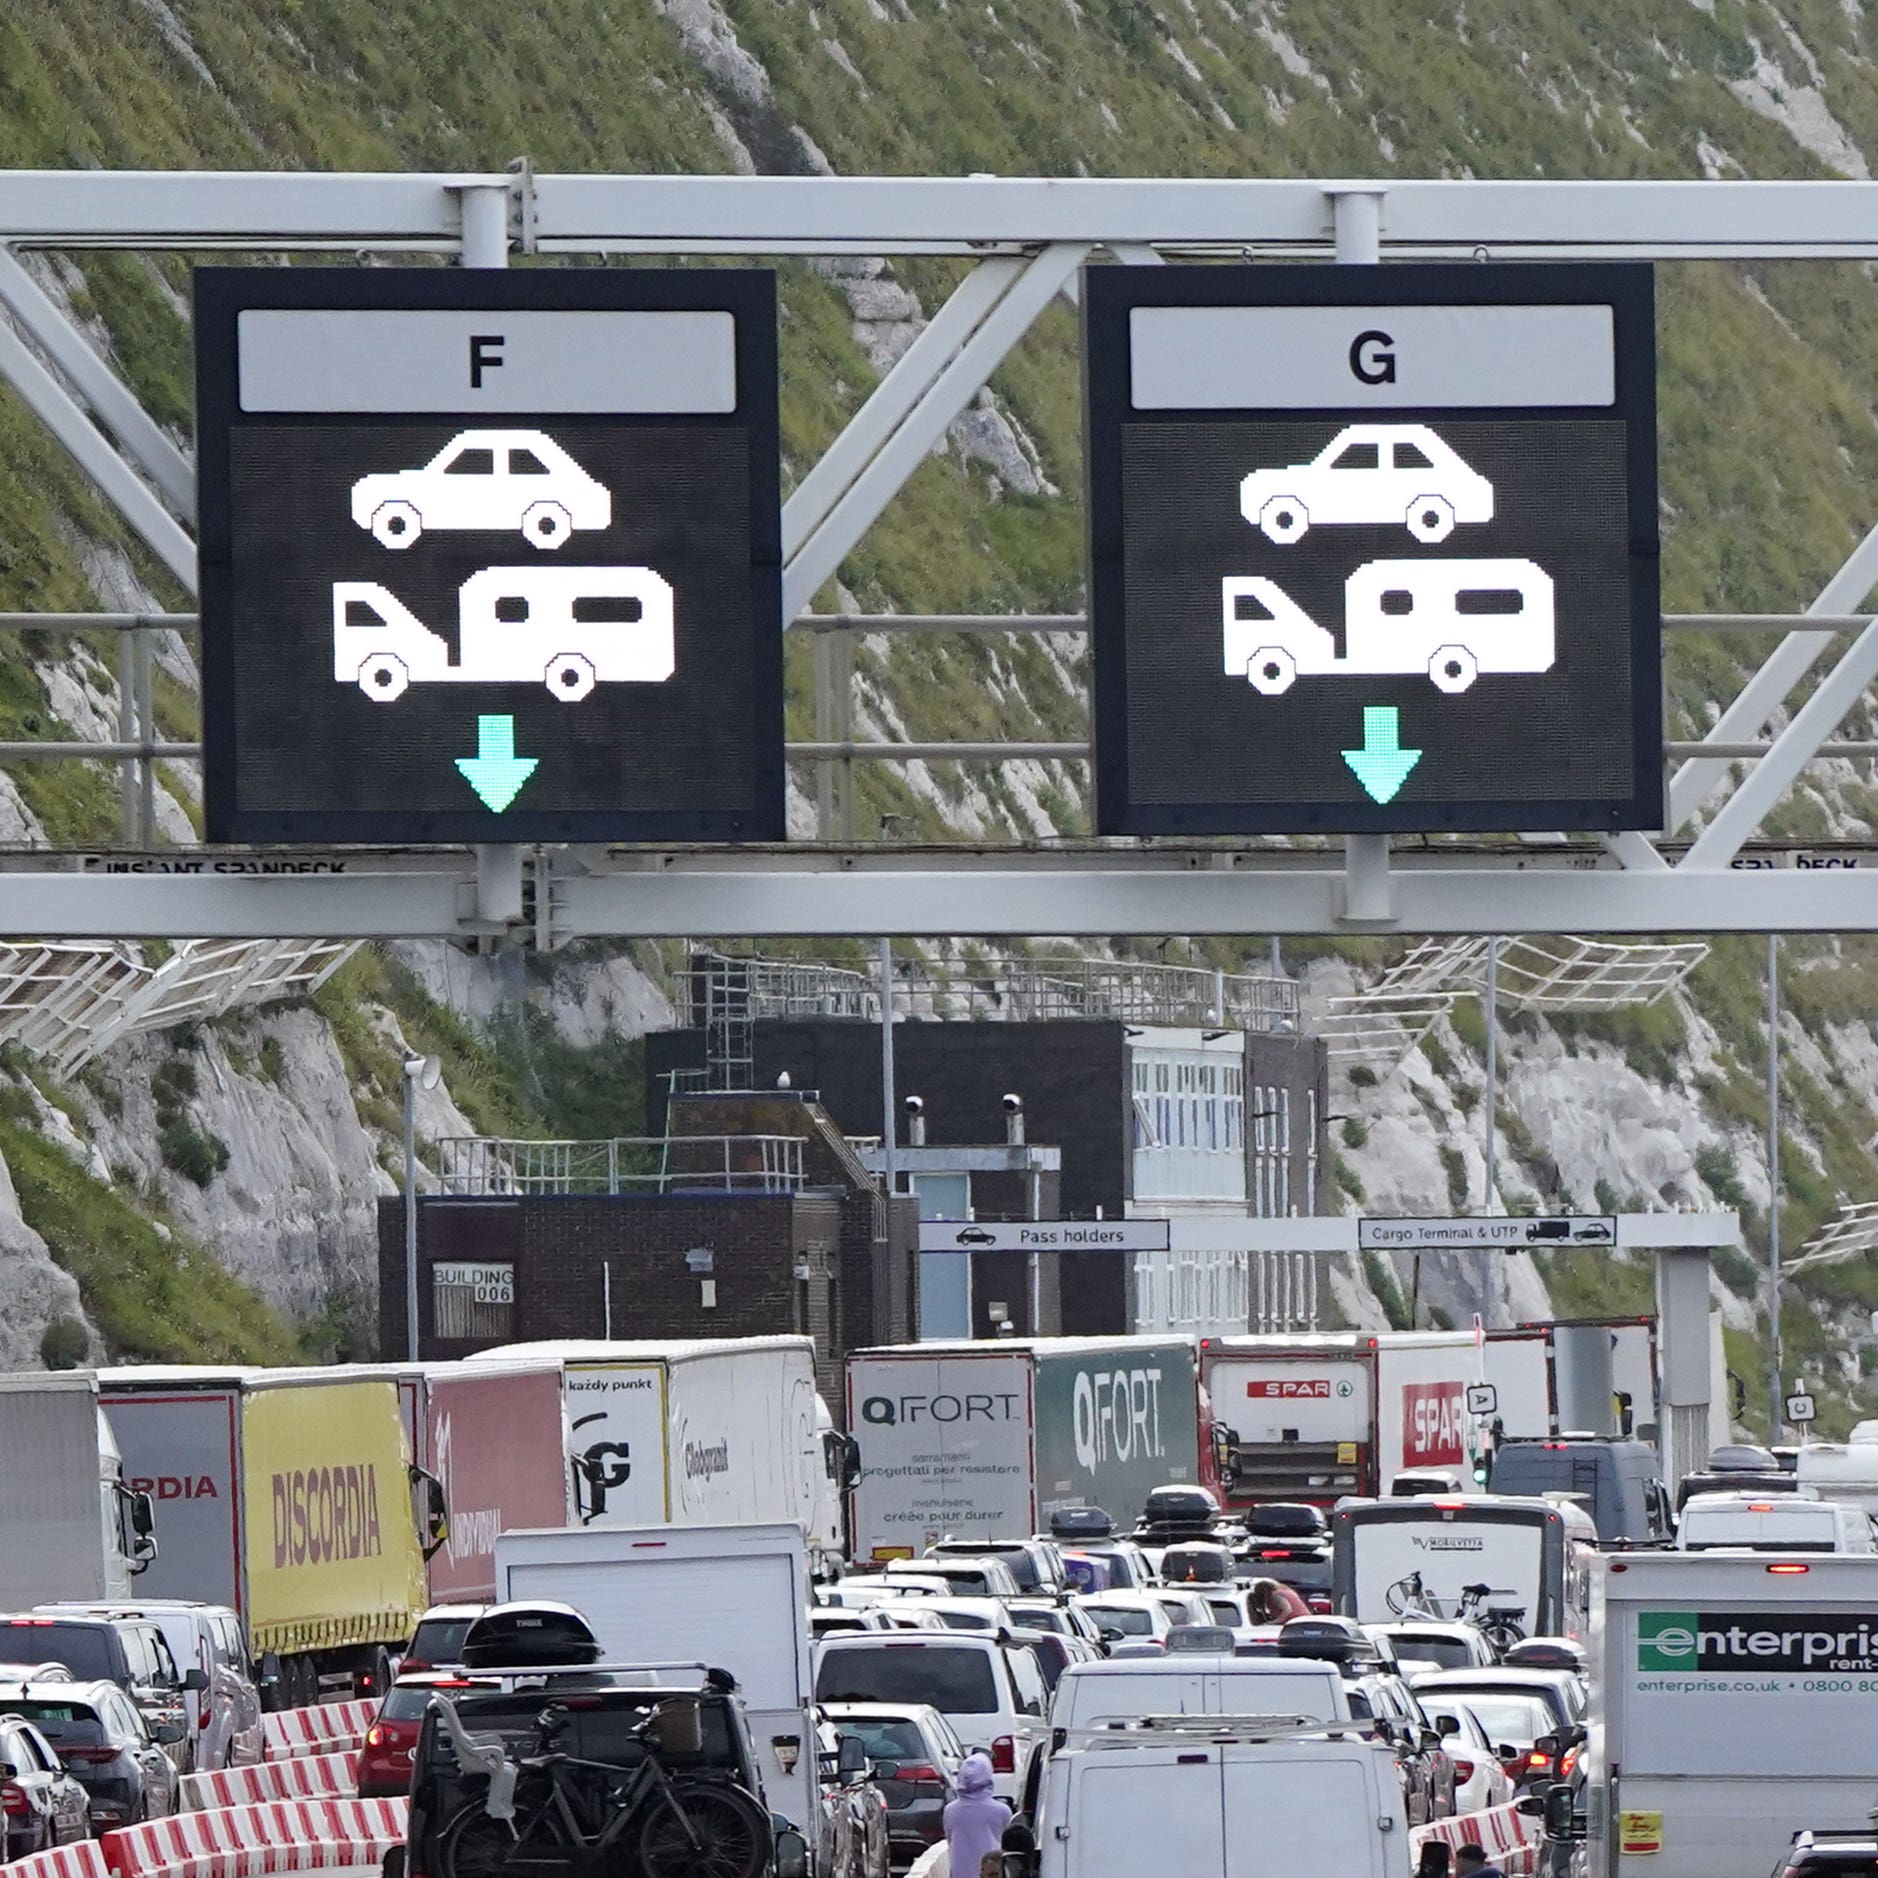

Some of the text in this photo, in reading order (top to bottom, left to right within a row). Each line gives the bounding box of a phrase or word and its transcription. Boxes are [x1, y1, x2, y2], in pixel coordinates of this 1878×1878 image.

[470, 336, 504, 388] F
[1350, 331, 1395, 384] G
[1020, 1229, 1124, 1243] Pass holders
[1372, 1226, 1518, 1242] Cargo Terminal & UTP
[433, 1269, 515, 1285] BUILDING
[477, 1287, 510, 1302] 006
[568, 1377, 652, 1392] każdy punkt
[1265, 1382, 1330, 1396] SPAR
[1414, 1396, 1464, 1453] SPAR
[936, 1466, 956, 1478] per
[960, 1463, 1021, 1475] resistere
[272, 1463, 383, 1569] DISCORDIA
[964, 1508, 1004, 1521] durer
[1637, 1680, 1781, 1694] enterprise.co.uk
[1803, 1680, 1852, 1693] 0800
